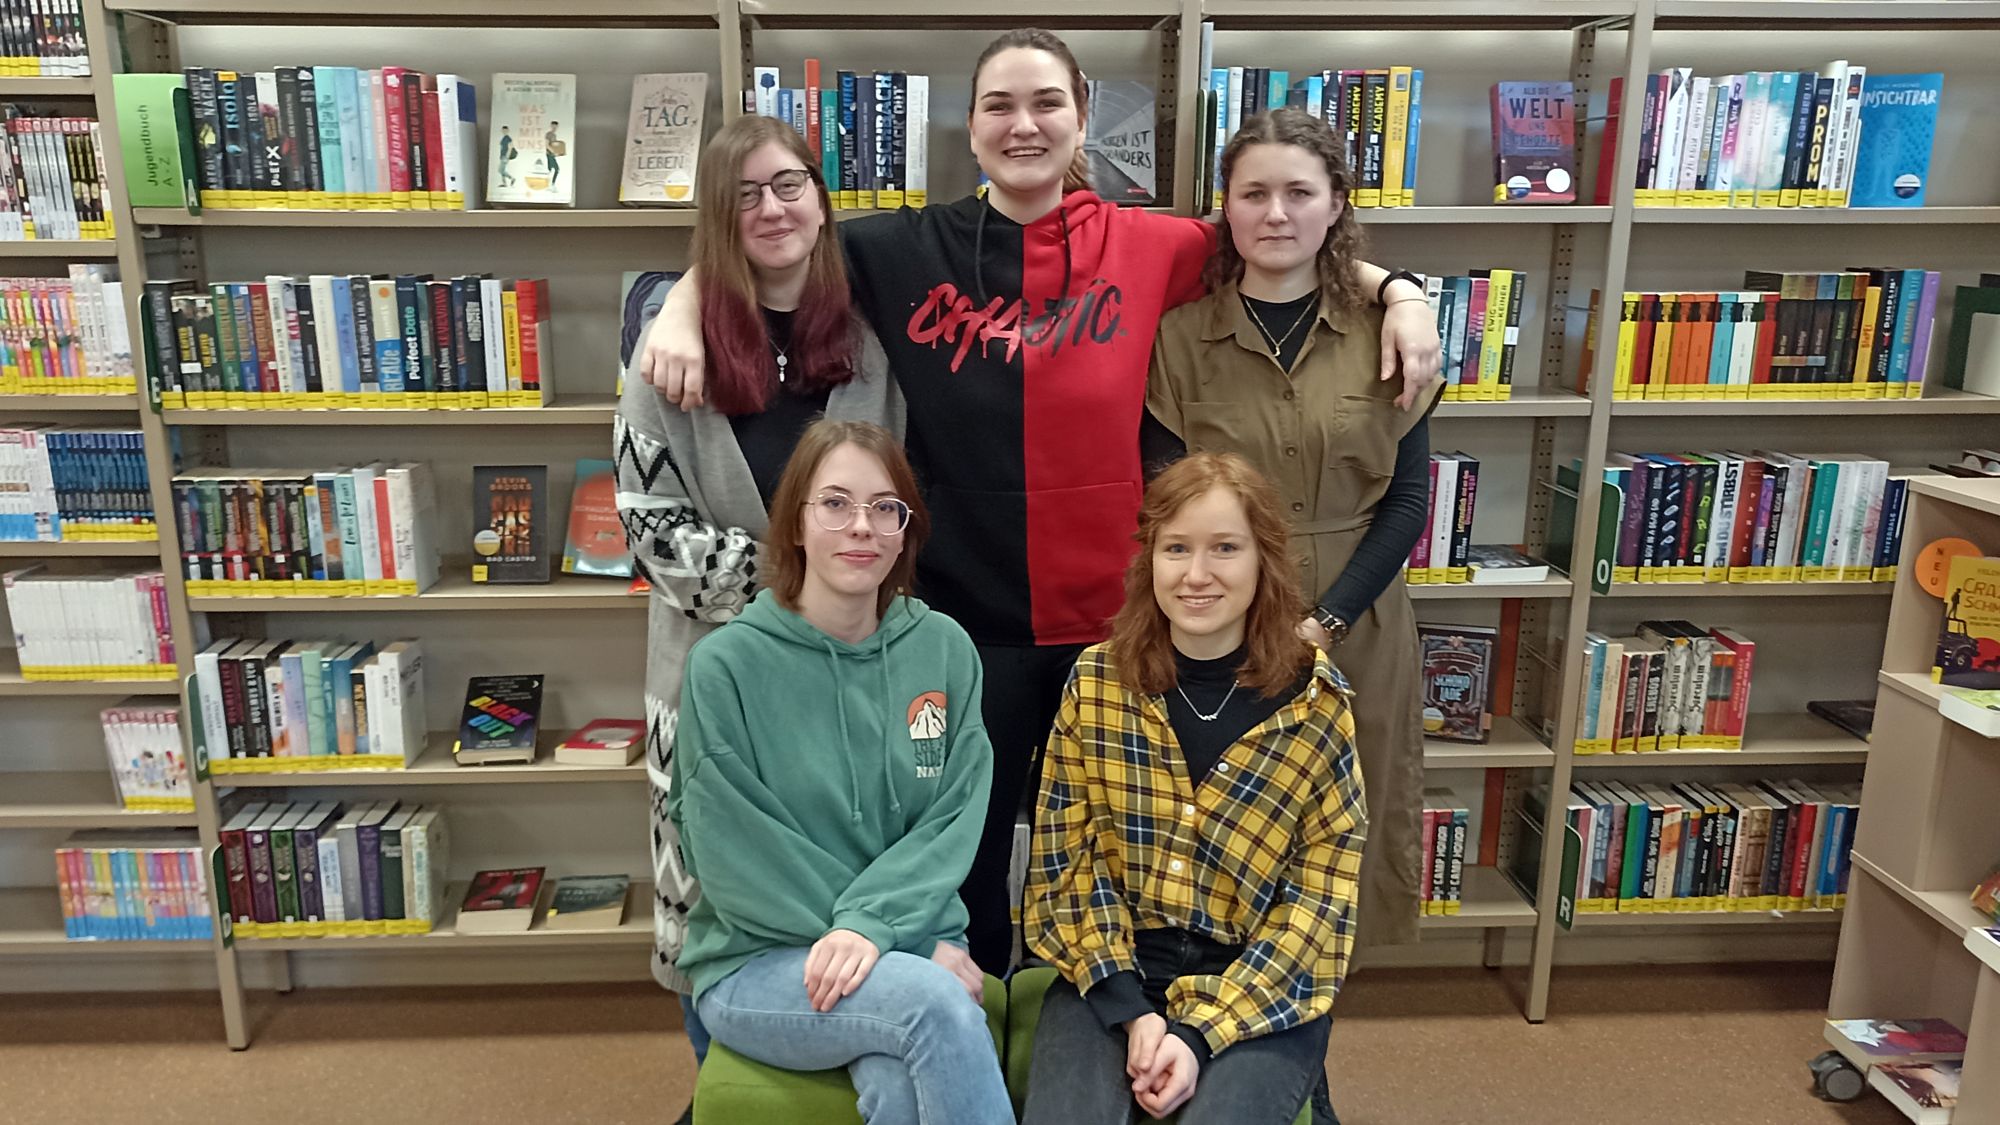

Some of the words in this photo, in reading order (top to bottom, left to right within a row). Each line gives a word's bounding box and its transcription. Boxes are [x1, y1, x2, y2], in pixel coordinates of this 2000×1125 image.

[199, 76, 217, 116] NACHT
[246, 94, 259, 122] ISOLA
[518, 104, 546, 114] WAS
[1351, 86, 1361, 133] ACADEMY
[1373, 86, 1385, 133] ACADEMY
[1509, 98, 1565, 119] WELT
[521, 116, 541, 126] IST
[644, 104, 689, 128] TAG
[875, 74, 892, 178] ESCHBACH
[137, 104, 157, 187] Jugendbuch
[517, 139, 544, 150] UNS
[519, 127, 543, 138] MIT
[893, 120, 905, 165] BLACK
[1131, 130, 1151, 147] IST
[1806, 105, 1828, 183] PROM
[162, 156, 171, 167] Z
[265, 145, 281, 160] X
[637, 155, 685, 170] LEBEN
[164, 177, 174, 187] A
[844, 162, 855, 188] UKAS
[188, 179, 198, 207] A
[1496, 285, 1507, 318] KEINER
[404, 305, 416, 335] Date
[1487, 309, 1497, 332] EWIG
[407, 336, 421, 380] Perfect
[1718, 461, 1739, 519] STIRBST
[1456, 498, 1467, 533] Letztendlich
[1883, 512, 1897, 554] RIVERDALE
[1713, 542, 1728, 567] ENN
[1963, 577, 2000, 599] CRA
[1645, 677, 1659, 713] EREBOS
[1666, 664, 1681, 712] Saeculum
[1689, 664, 1704, 712] Saeculum
[468, 714, 515, 738] OUT
[1433, 858, 1446, 886] CAMP
[1449, 858, 1462, 886] CAMP
[1559, 896, 1571, 922] R
